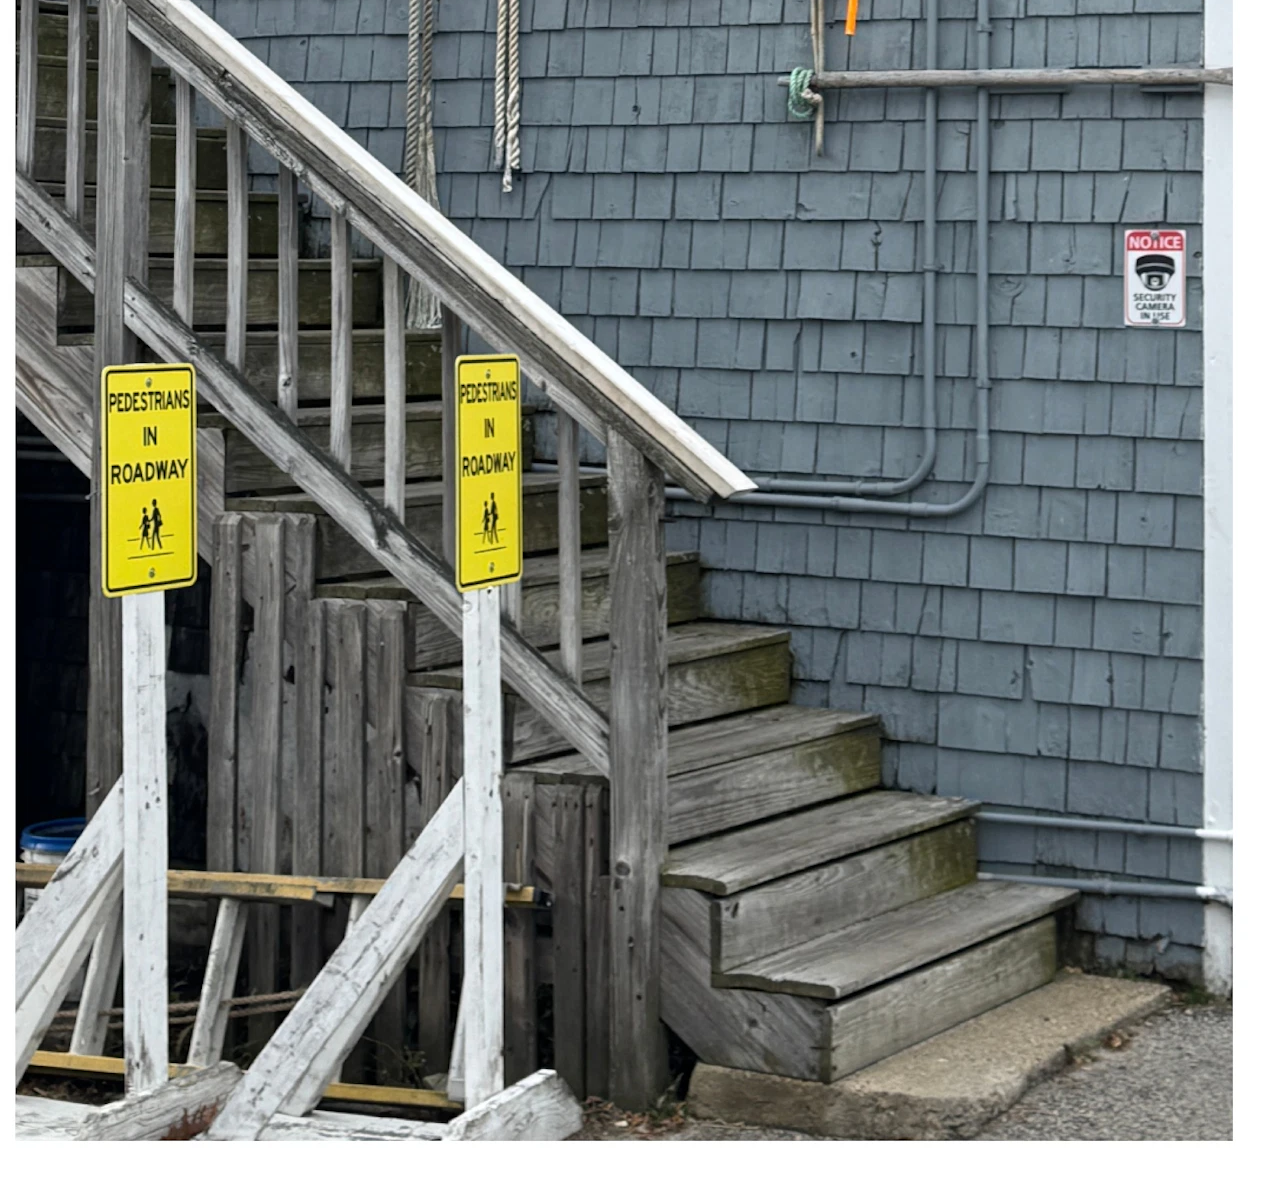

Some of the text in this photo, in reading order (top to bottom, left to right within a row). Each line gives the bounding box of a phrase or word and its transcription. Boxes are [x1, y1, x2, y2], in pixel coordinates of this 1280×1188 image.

[1133, 293, 1177, 302] SECURITY
[1135, 302, 1175, 311] CAMERA
[1153, 312, 1171, 320] USE
[109, 389, 190, 413] PEDESTRIANS
[460, 381, 517, 404] PEDESTRIANS
[143, 426, 157, 446] IN
[484, 417, 495, 438] IN
[111, 458, 189, 485] ROADWAY
[462, 451, 516, 477] ROADWAY
